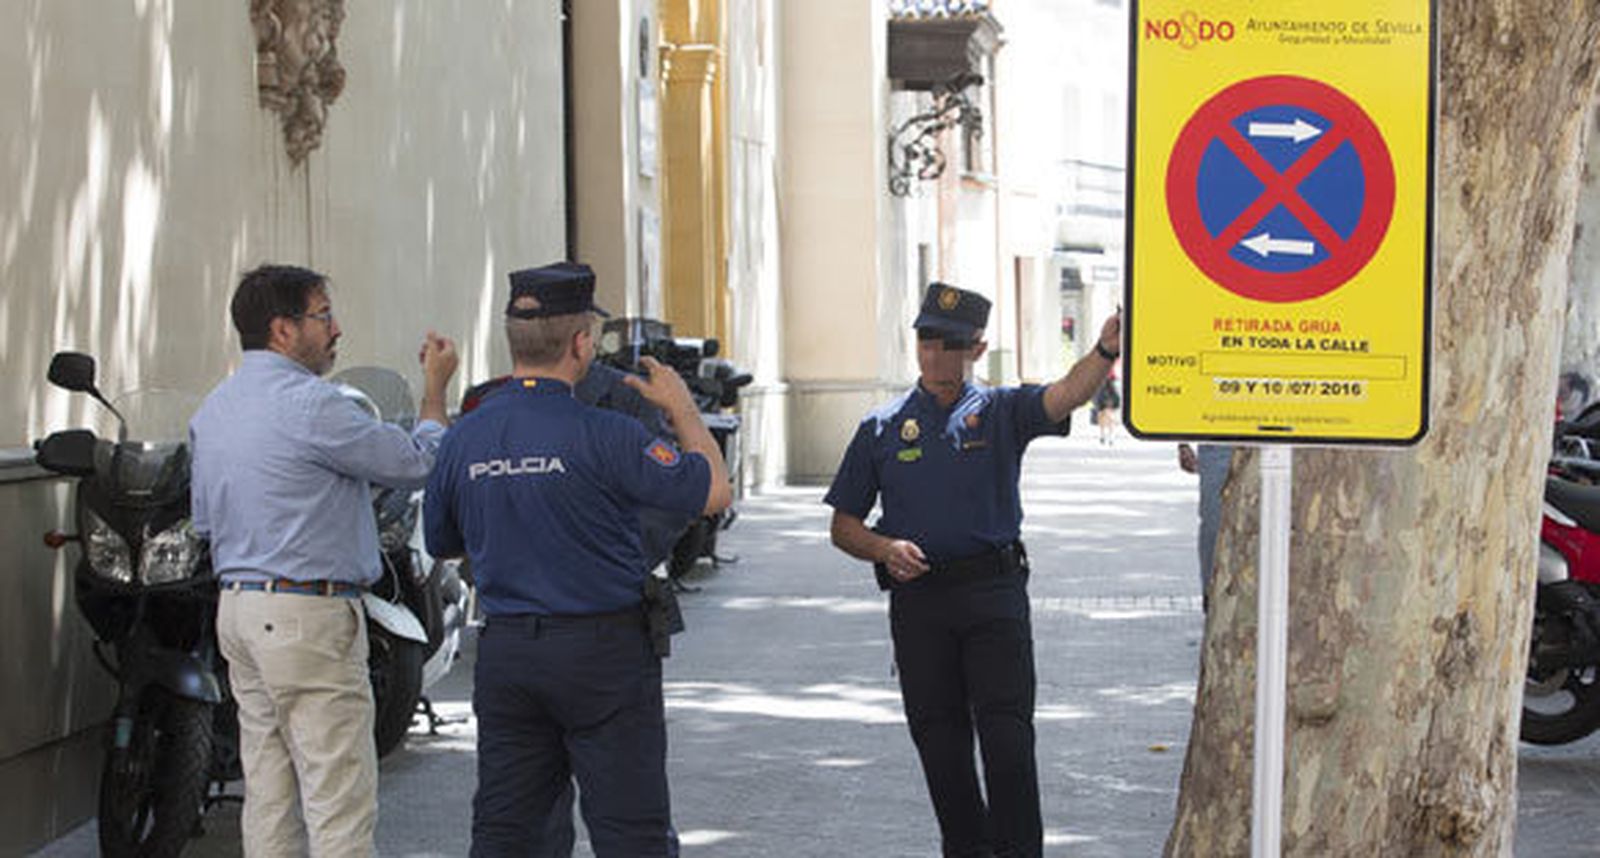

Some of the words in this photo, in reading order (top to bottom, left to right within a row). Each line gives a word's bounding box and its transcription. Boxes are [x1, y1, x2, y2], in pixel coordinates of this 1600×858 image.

[1213, 318, 1293, 333] RETIRADA
[1221, 336, 1243, 348] EN
[1249, 337, 1291, 350] TODA
[1296, 339, 1316, 350] LA
[1320, 339, 1370, 352] CALLE
[1146, 355, 1197, 367] MOTIVO
[1219, 381, 1240, 394] 09
[1247, 382, 1257, 394] Y
[1321, 382, 1362, 396] 2016
